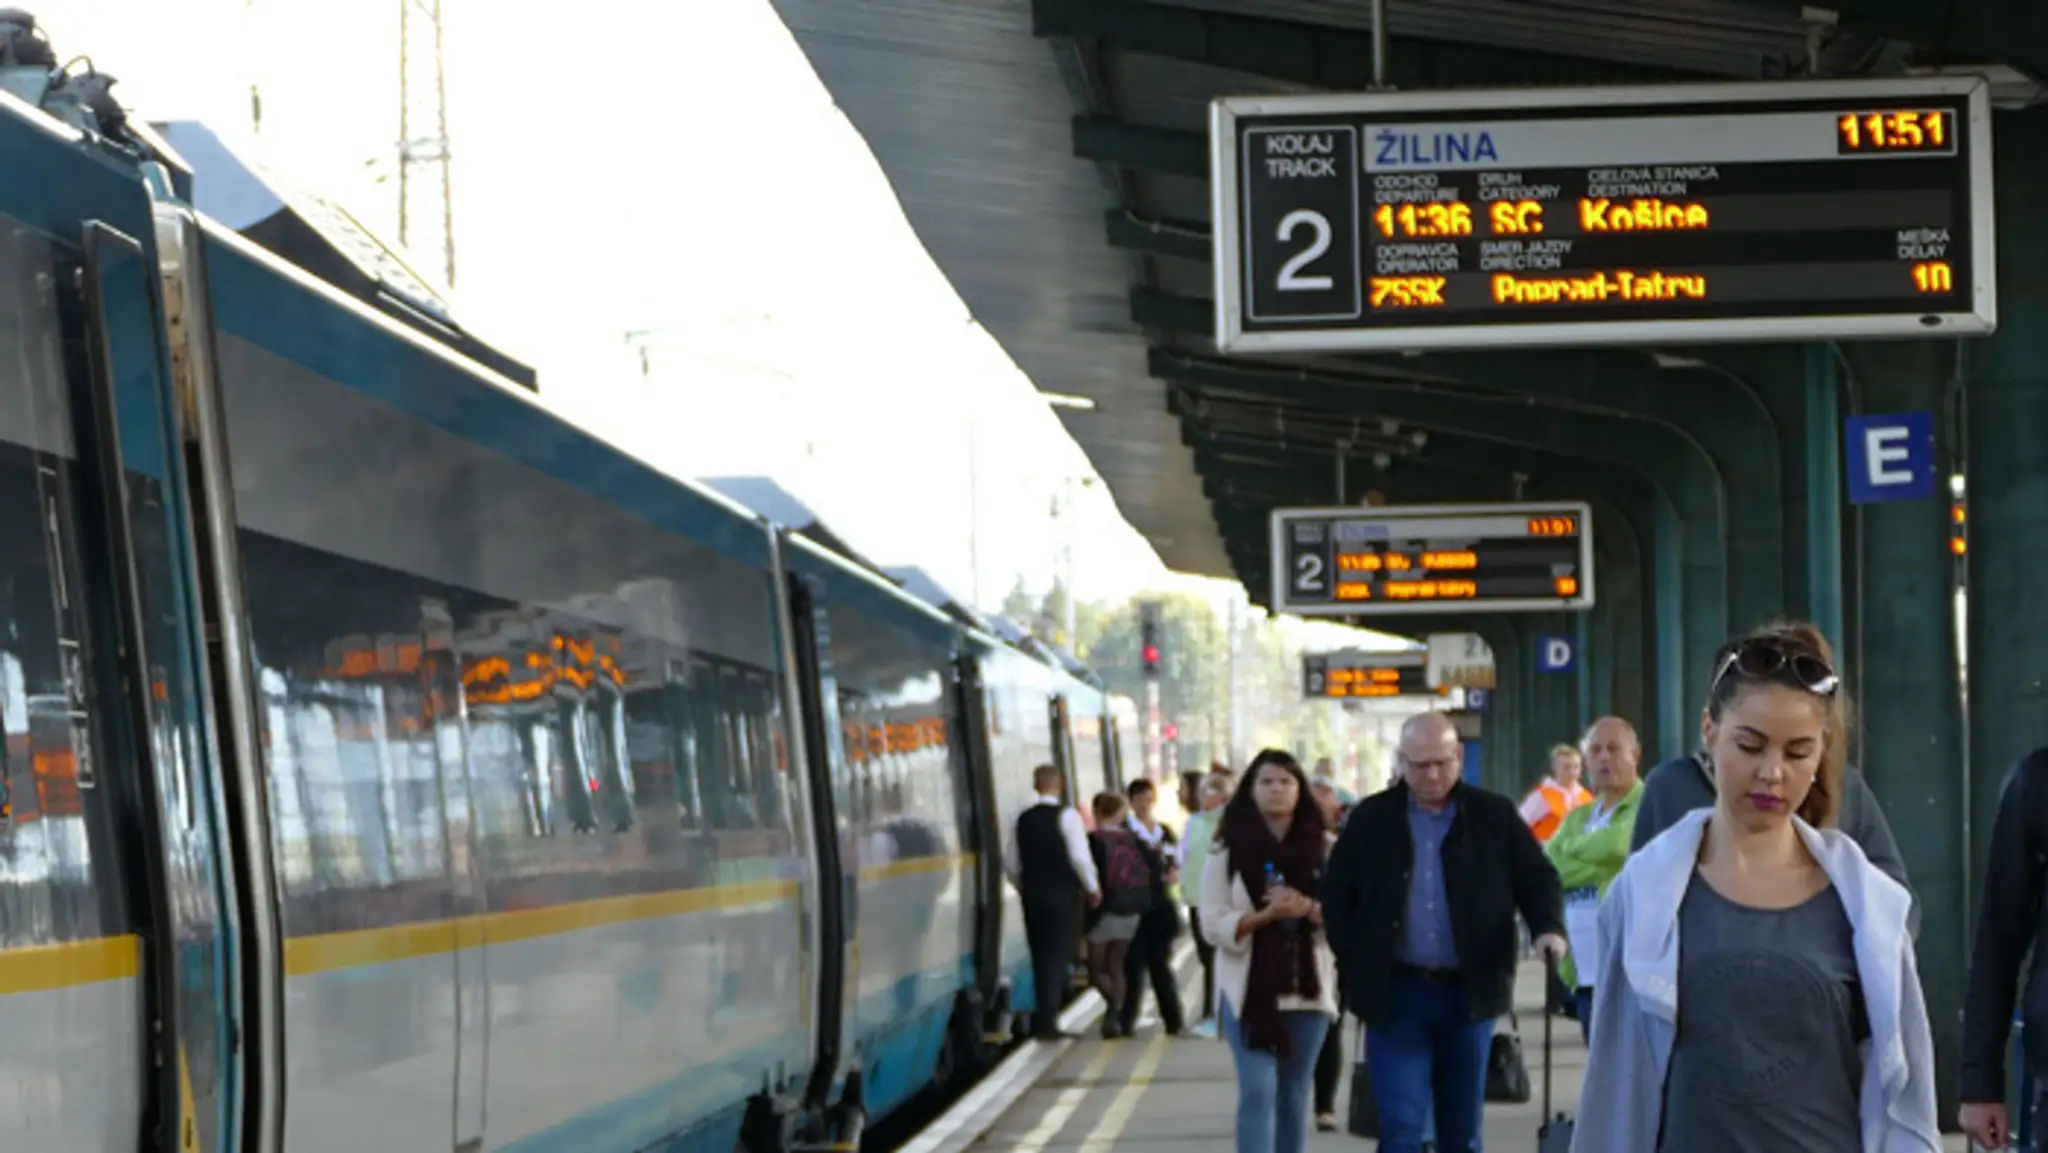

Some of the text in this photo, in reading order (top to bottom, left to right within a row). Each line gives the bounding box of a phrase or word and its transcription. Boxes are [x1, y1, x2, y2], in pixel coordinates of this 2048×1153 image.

[1840, 111, 1944, 147] 11:51
[1375, 128, 1498, 165] ŽILINA
[1266, 157, 1336, 179] TRACK
[1375, 187, 1459, 203] DEPARTURE
[1478, 184, 1561, 200] CATEGORY
[1588, 181, 1688, 198] DESTINATION
[1374, 200, 1473, 237] 11:36
[1277, 208, 1334, 291] 2
[1898, 243, 1947, 259] DELAY
[1376, 256, 1459, 274] OPERATOR
[1480, 254, 1562, 271] DIRECTION
[1865, 426, 1914, 487] E
[1297, 553, 1324, 590] 2
[1546, 640, 1571, 668] D
